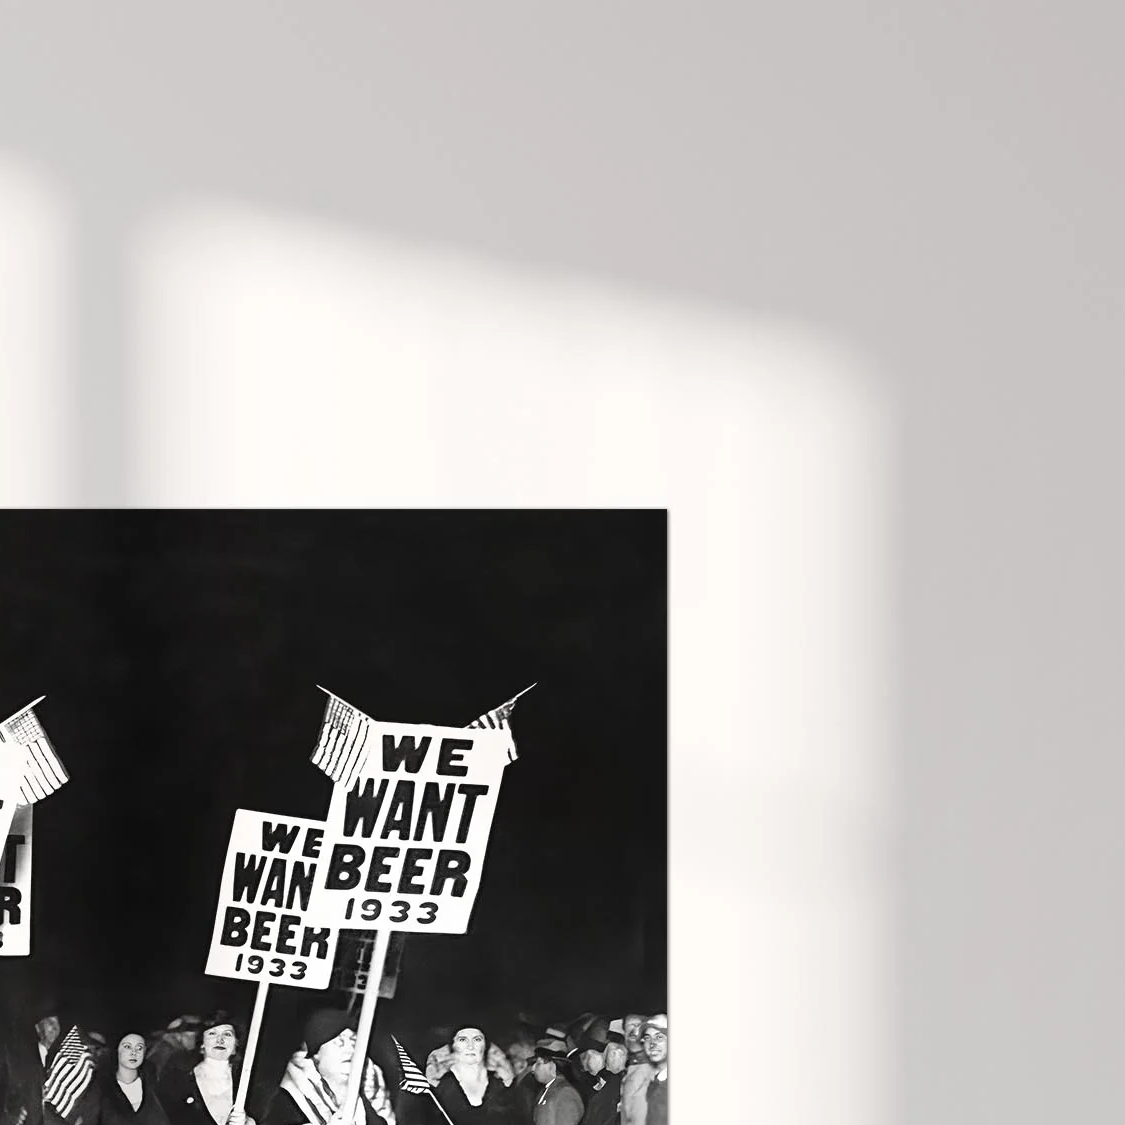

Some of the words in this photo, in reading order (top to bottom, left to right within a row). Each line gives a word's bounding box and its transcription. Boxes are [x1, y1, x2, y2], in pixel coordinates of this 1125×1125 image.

[383, 735, 473, 777] WE
[343, 776, 489, 843] WANT
[262, 821, 325, 858] WE
[233, 852, 318, 911] WAN
[325, 844, 471, 897] BEER
[220, 907, 331, 959] BEER
[345, 898, 438, 924] 1933
[235, 954, 307, 980] 1933
